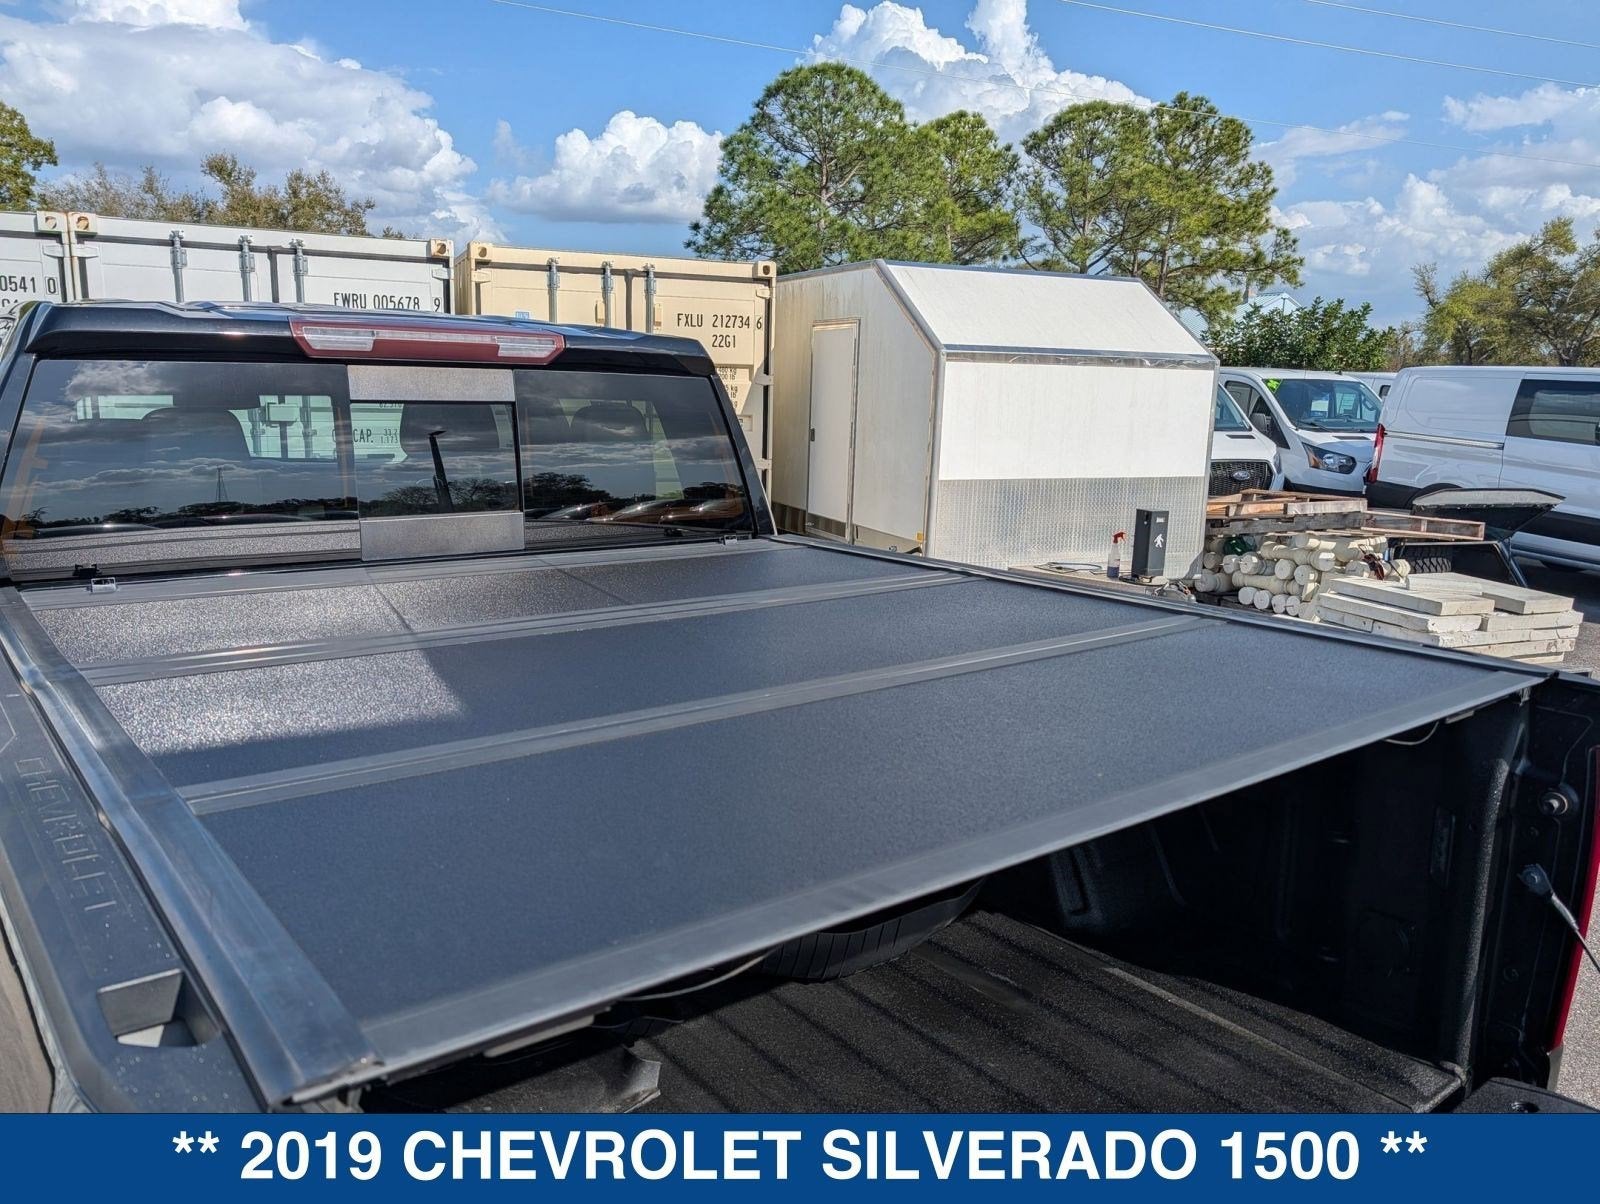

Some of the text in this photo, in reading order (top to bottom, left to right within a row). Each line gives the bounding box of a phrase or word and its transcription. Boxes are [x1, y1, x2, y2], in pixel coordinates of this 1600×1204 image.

[433, 297, 441, 312] 9
[677, 313, 762, 330] FXLU 212734 6
[711, 334, 736, 348] 22G1
[353, 429, 374, 443] CAP.
[14, 757, 117, 911] CHEVROLET
